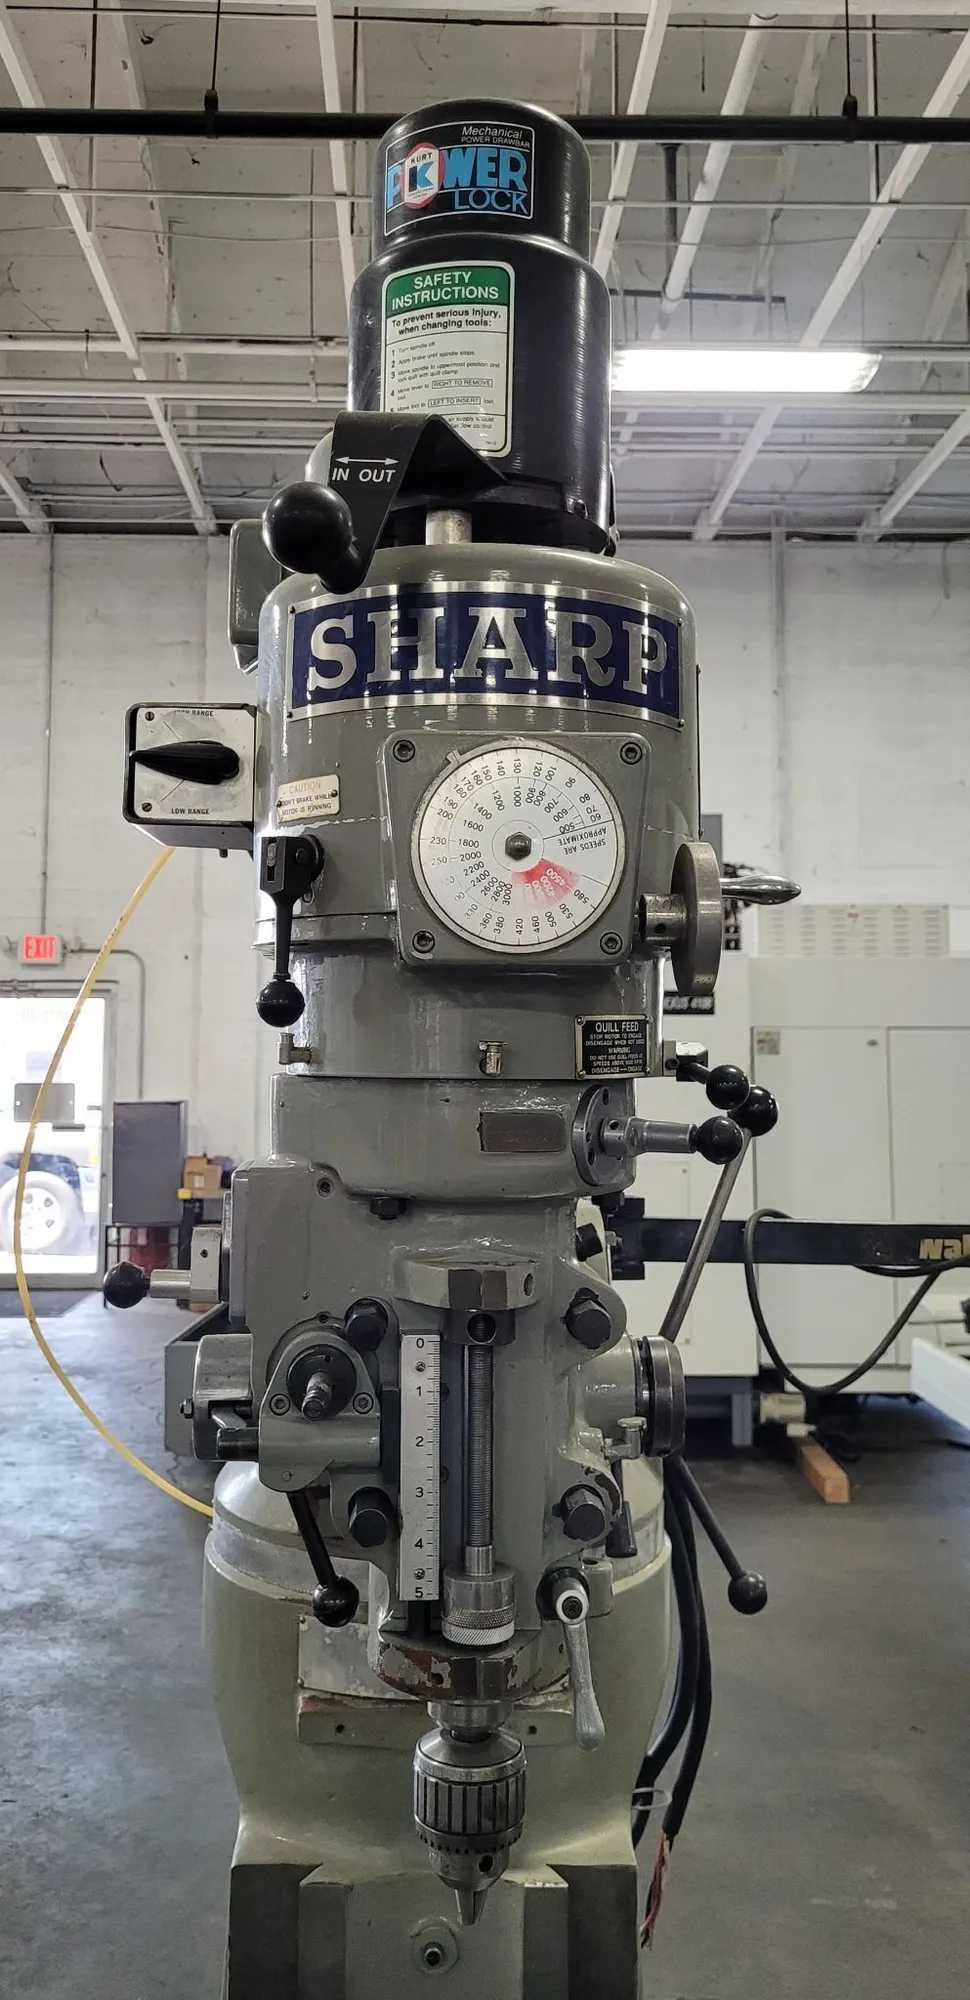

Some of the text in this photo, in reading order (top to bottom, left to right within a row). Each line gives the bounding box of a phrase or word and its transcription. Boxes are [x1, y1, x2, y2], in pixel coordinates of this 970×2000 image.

[462, 126, 523, 139] Mechanical
[461, 136, 531, 148] POWER DRAWBAR
[410, 152, 432, 165] KURT
[454, 189, 528, 214] LOCK
[414, 271, 472, 289] SAFETY
[391, 286, 499, 310] INSTRUCTIONS
[392, 308, 502, 328] To prevent serious injury,
[398, 318, 492, 335] when changing tools:
[331, 467, 396, 483] IN OUT
[308, 606, 668, 696] SHARP
[482, 765, 492, 781] 150
[496, 761, 506, 776] 140
[513, 759, 521, 774] 130
[533, 761, 543, 777] 120
[545, 766, 557, 781] 100
[461, 776, 474, 792] 170
[470, 770, 483, 786] 160
[564, 777, 576, 788] 90
[453, 784, 467, 798] 180
[513, 785, 522, 807] 1000
[525, 787, 536, 804] 900
[533, 790, 546, 807] 800
[579, 793, 591, 804] 80
[444, 796, 458, 809] 190
[492, 790, 505, 811] 1200
[544, 798, 559, 813] 700
[188, 808, 210, 816] RANGE
[437, 808, 454, 820] 200
[473, 803, 493, 820] 1400
[553, 808, 569, 822] 600
[585, 804, 597, 815] 70
[463, 819, 484, 832] 1600
[589, 813, 602, 823] 60
[559, 822, 576, 834] 500
[430, 836, 447, 845] 230
[458, 838, 480, 849] 1800
[559, 827, 607, 846] APPROXIMATE
[564, 838, 607, 855] SPEEDS ARE
[460, 850, 482, 861] 2000
[463, 861, 485, 876] 2200
[470, 870, 490, 887] 2400
[480, 876, 499, 896] 2600
[490, 880, 506, 902] 2800
[502, 883, 513, 905] 3000
[573, 889, 590, 904] 580
[559, 903, 574, 919] 530
[480, 912, 493, 929] 360
[493, 916, 505, 935] 380
[515, 918, 524, 935] 420
[531, 915, 540, 934] 460
[545, 911, 557, 928] 500
[24, 936, 57, 959] EXIT
[595, 1021, 639, 1033] QUILL FEED
[416, 1338, 425, 1349] 0
[416, 1386, 423, 1396] 1
[415, 1437, 424, 1447] 2
[415, 1488, 424, 1498] 3
[414, 1538, 424, 1549] 4
[415, 1587, 424, 1598] 5
